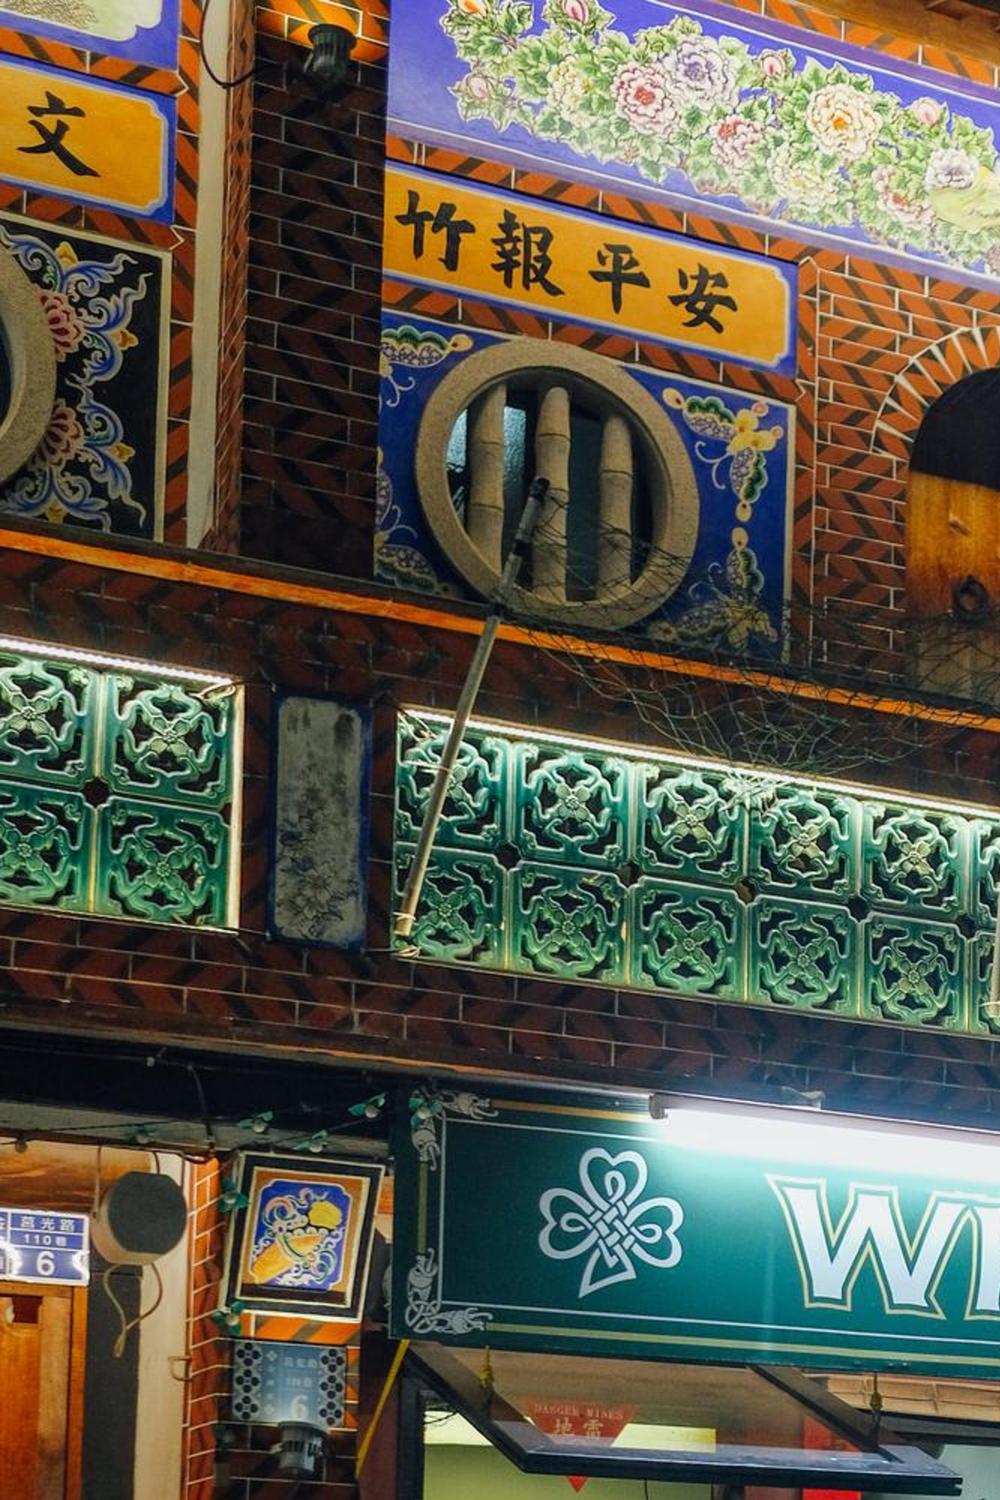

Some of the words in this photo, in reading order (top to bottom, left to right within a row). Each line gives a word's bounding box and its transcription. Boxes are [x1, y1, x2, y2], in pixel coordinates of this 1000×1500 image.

[16, 90, 100, 178] 文
[394, 190, 739, 334] 竹報平安
[36, 1251, 55, 1276] 6
